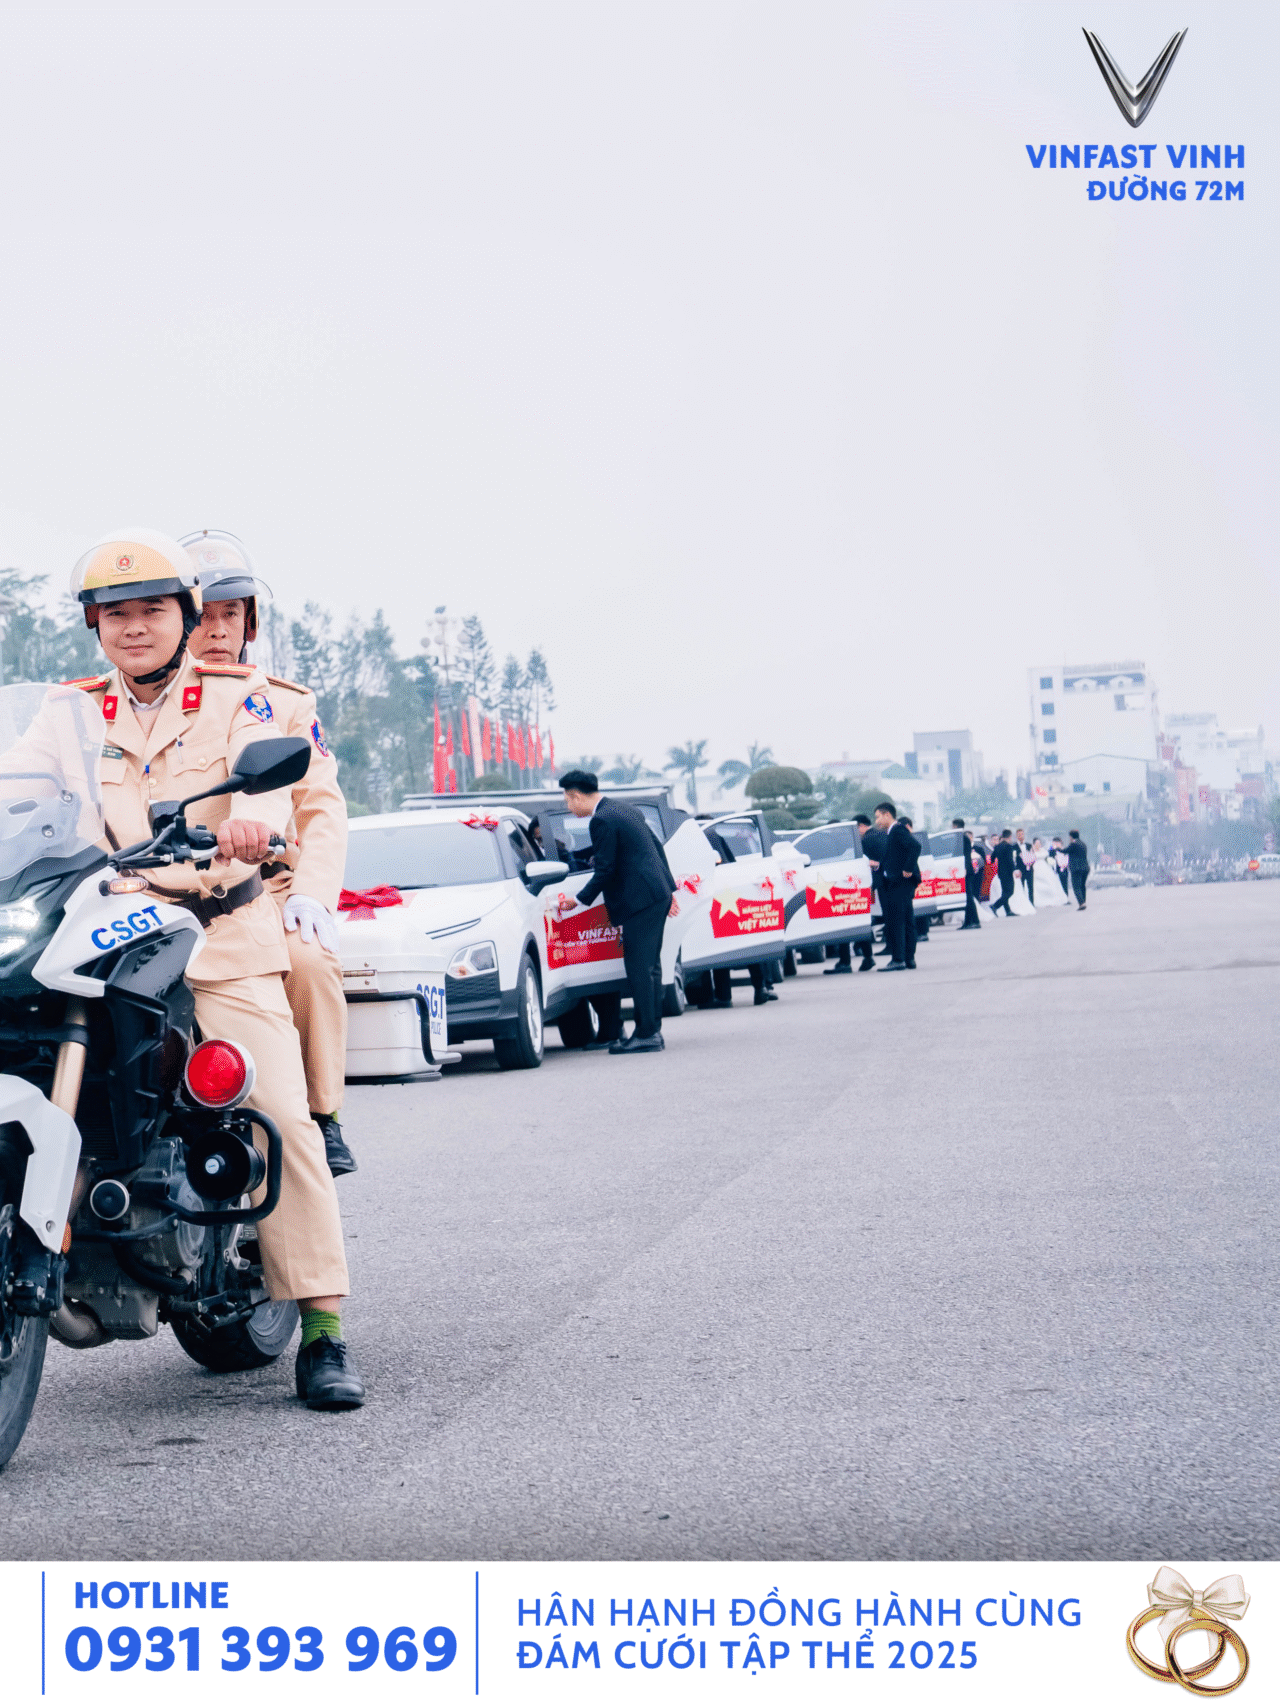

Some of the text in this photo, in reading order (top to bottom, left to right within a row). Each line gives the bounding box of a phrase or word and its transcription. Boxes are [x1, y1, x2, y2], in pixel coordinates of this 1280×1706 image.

[831, 902, 868, 914] VIỆT NAM
[738, 917, 779, 932] VIỆT NAM
[577, 925, 623, 940] VINFAST
